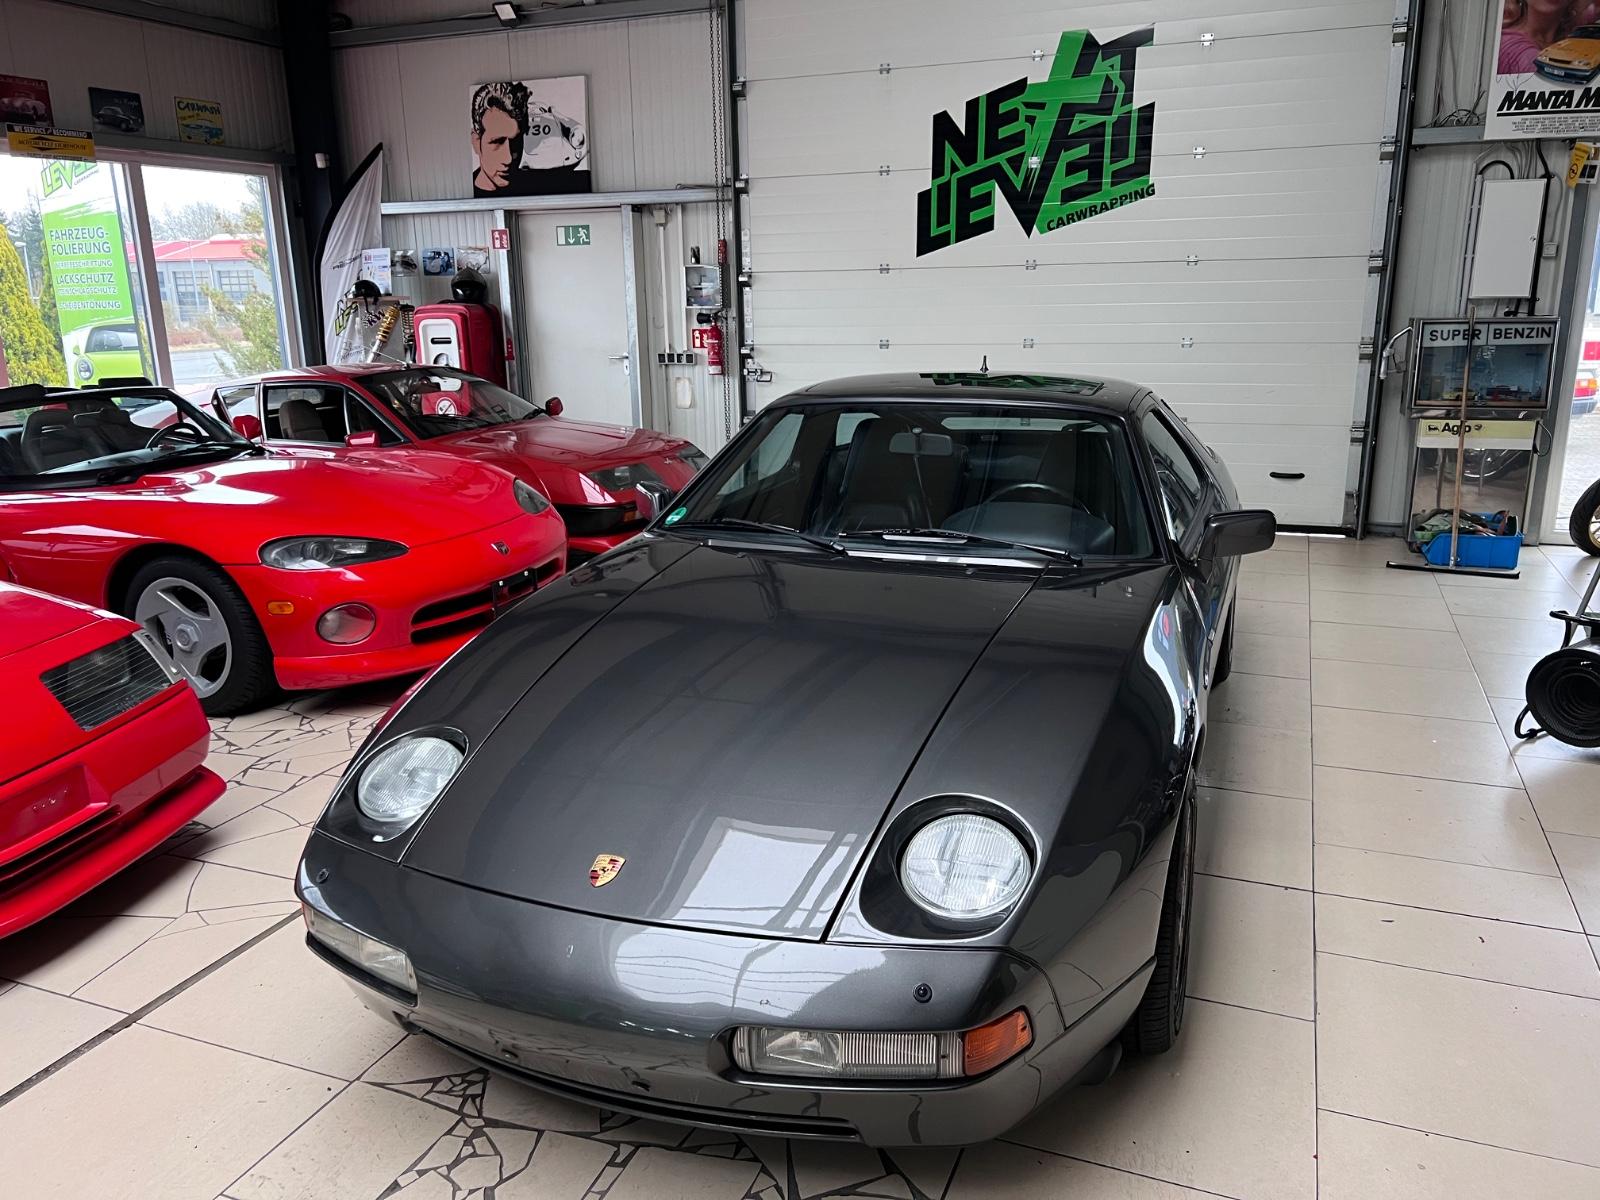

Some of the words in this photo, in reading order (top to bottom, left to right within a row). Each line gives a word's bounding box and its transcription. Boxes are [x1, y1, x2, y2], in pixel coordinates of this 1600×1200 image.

[1497, 89, 1575, 112] MANTA
[916, 100, 1156, 258] LEVEL
[1046, 182, 1156, 232] CARWRAPPING
[49, 226, 109, 241] FAHRZEUG-
[51, 241, 112, 256] FOLIERUNG
[56, 272, 115, 285] LACKSCHUTZ
[1429, 328, 1482, 341] SUPER
[1493, 326, 1552, 340] BENZIN
[1441, 422, 1472, 437] Agp
